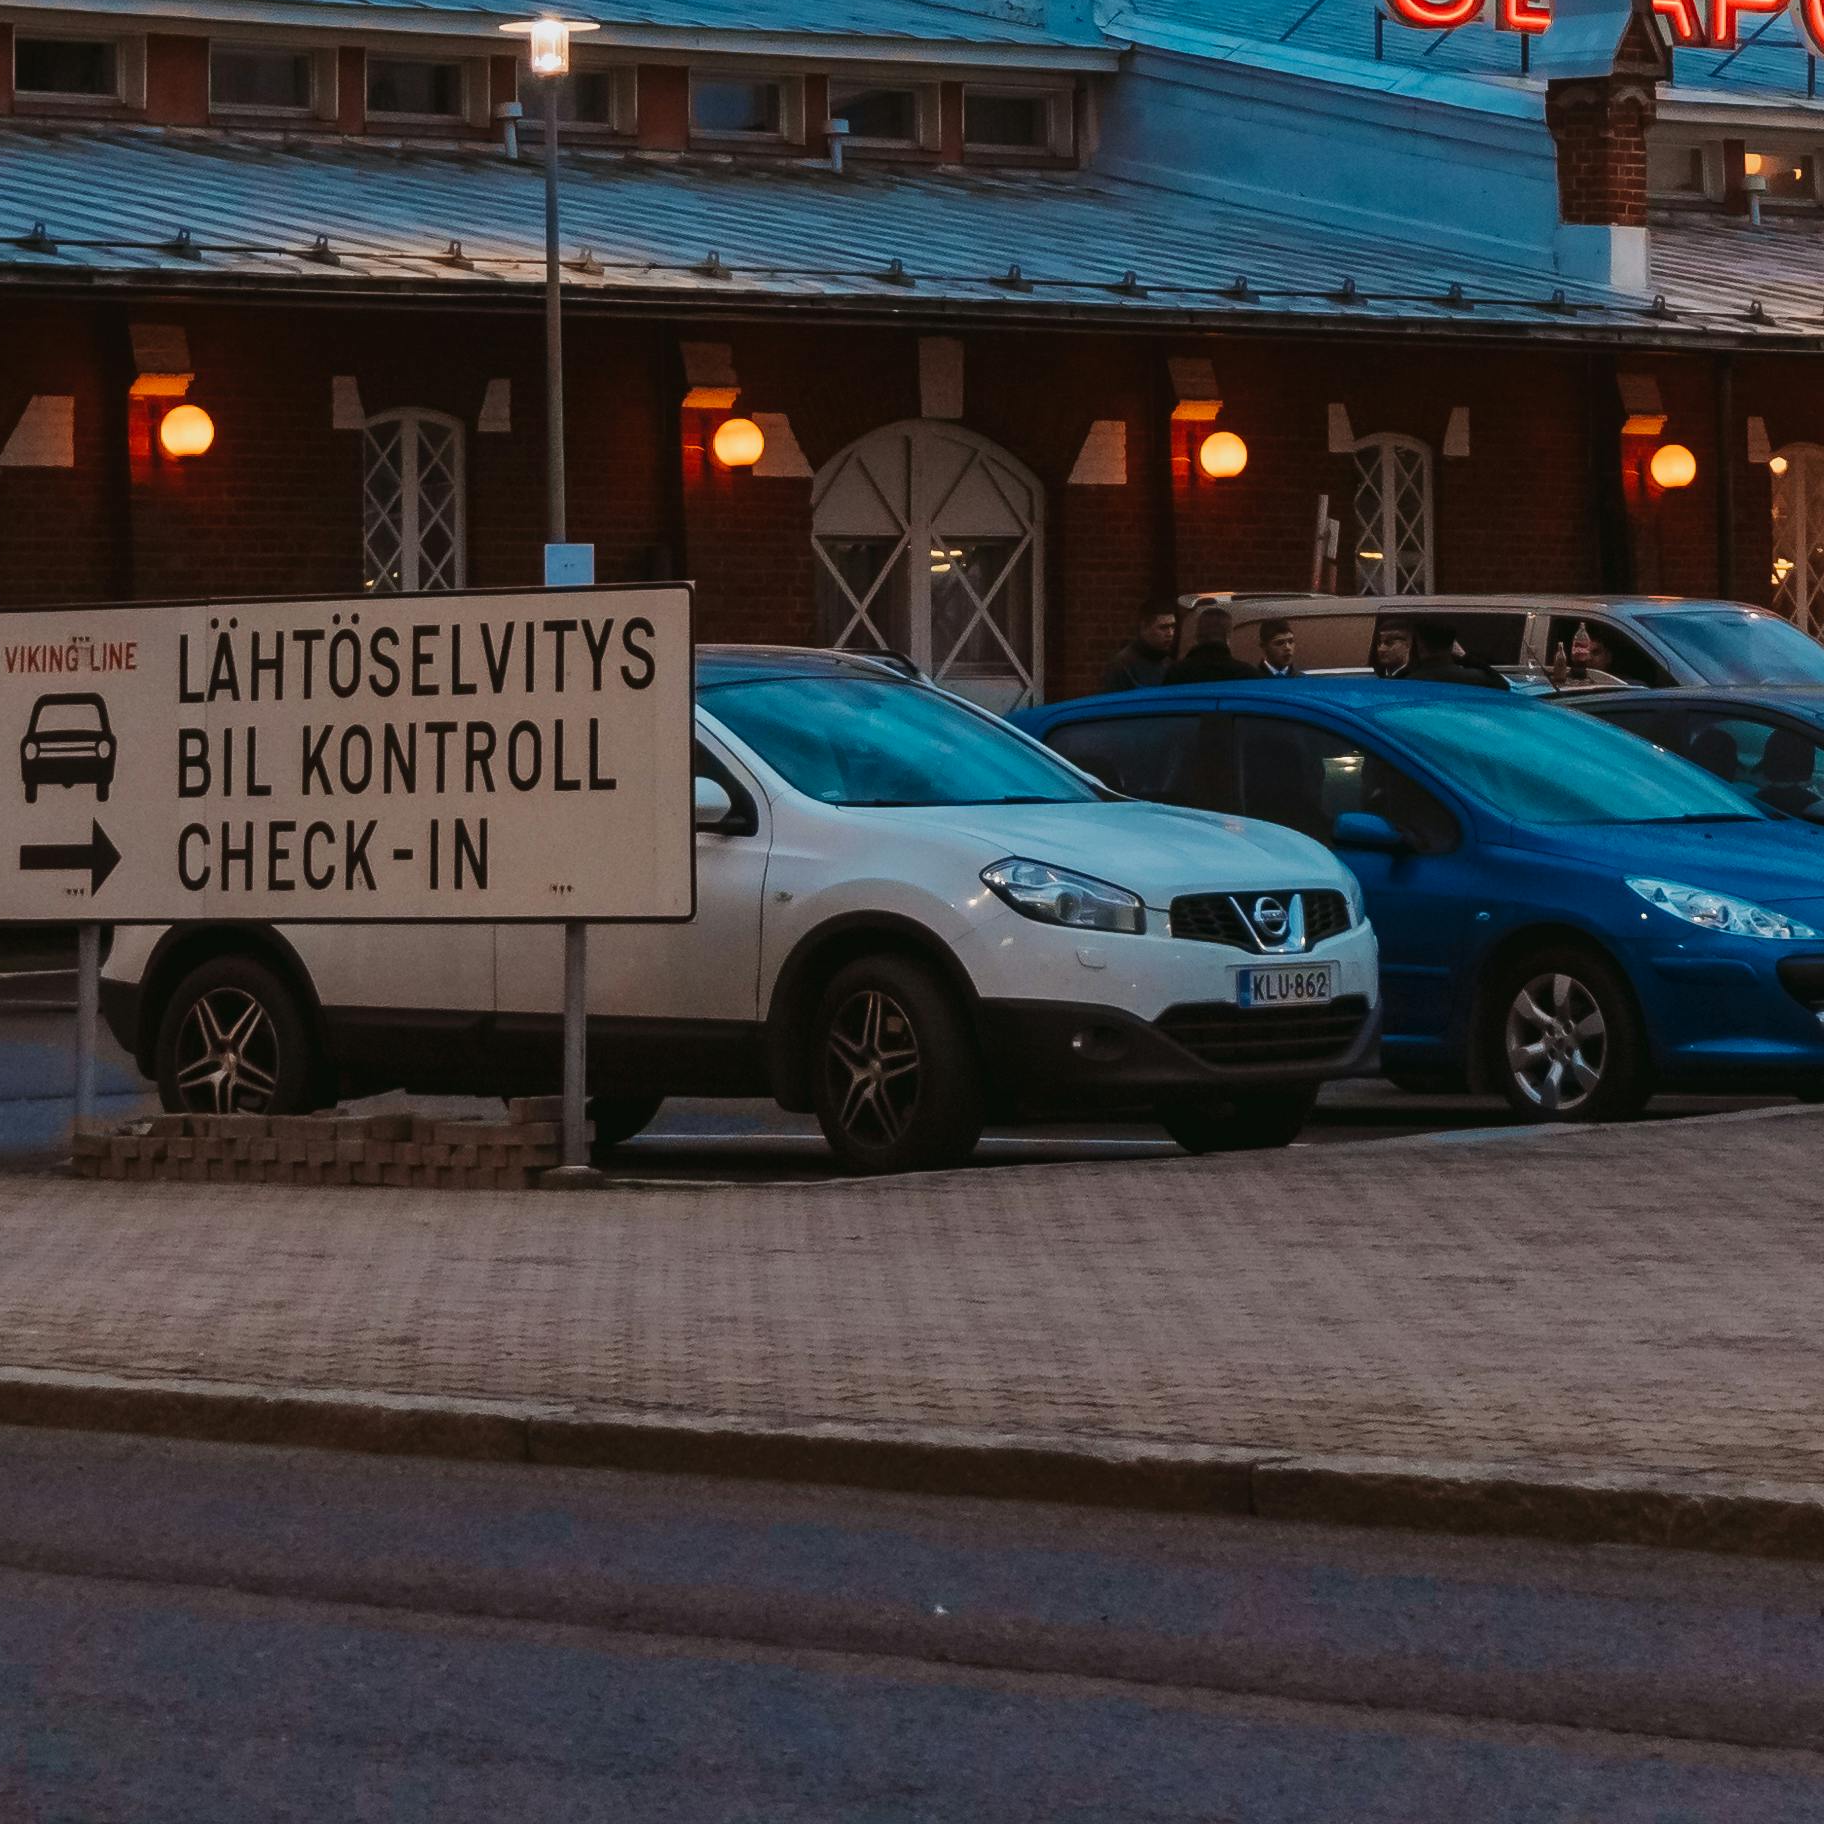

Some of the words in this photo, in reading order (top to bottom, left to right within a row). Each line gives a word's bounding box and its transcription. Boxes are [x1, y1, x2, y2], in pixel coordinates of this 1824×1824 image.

[5, 644, 78, 673] VIKING
[90, 642, 137, 672] LINE
[178, 613, 657, 704] LÄHTÖSELVITYS
[178, 725, 272, 798] BIL
[302, 717, 618, 796] KONTROLL
[178, 818, 490, 892] CHECK-IN
[1253, 972, 1326, 1001] KLU-862
